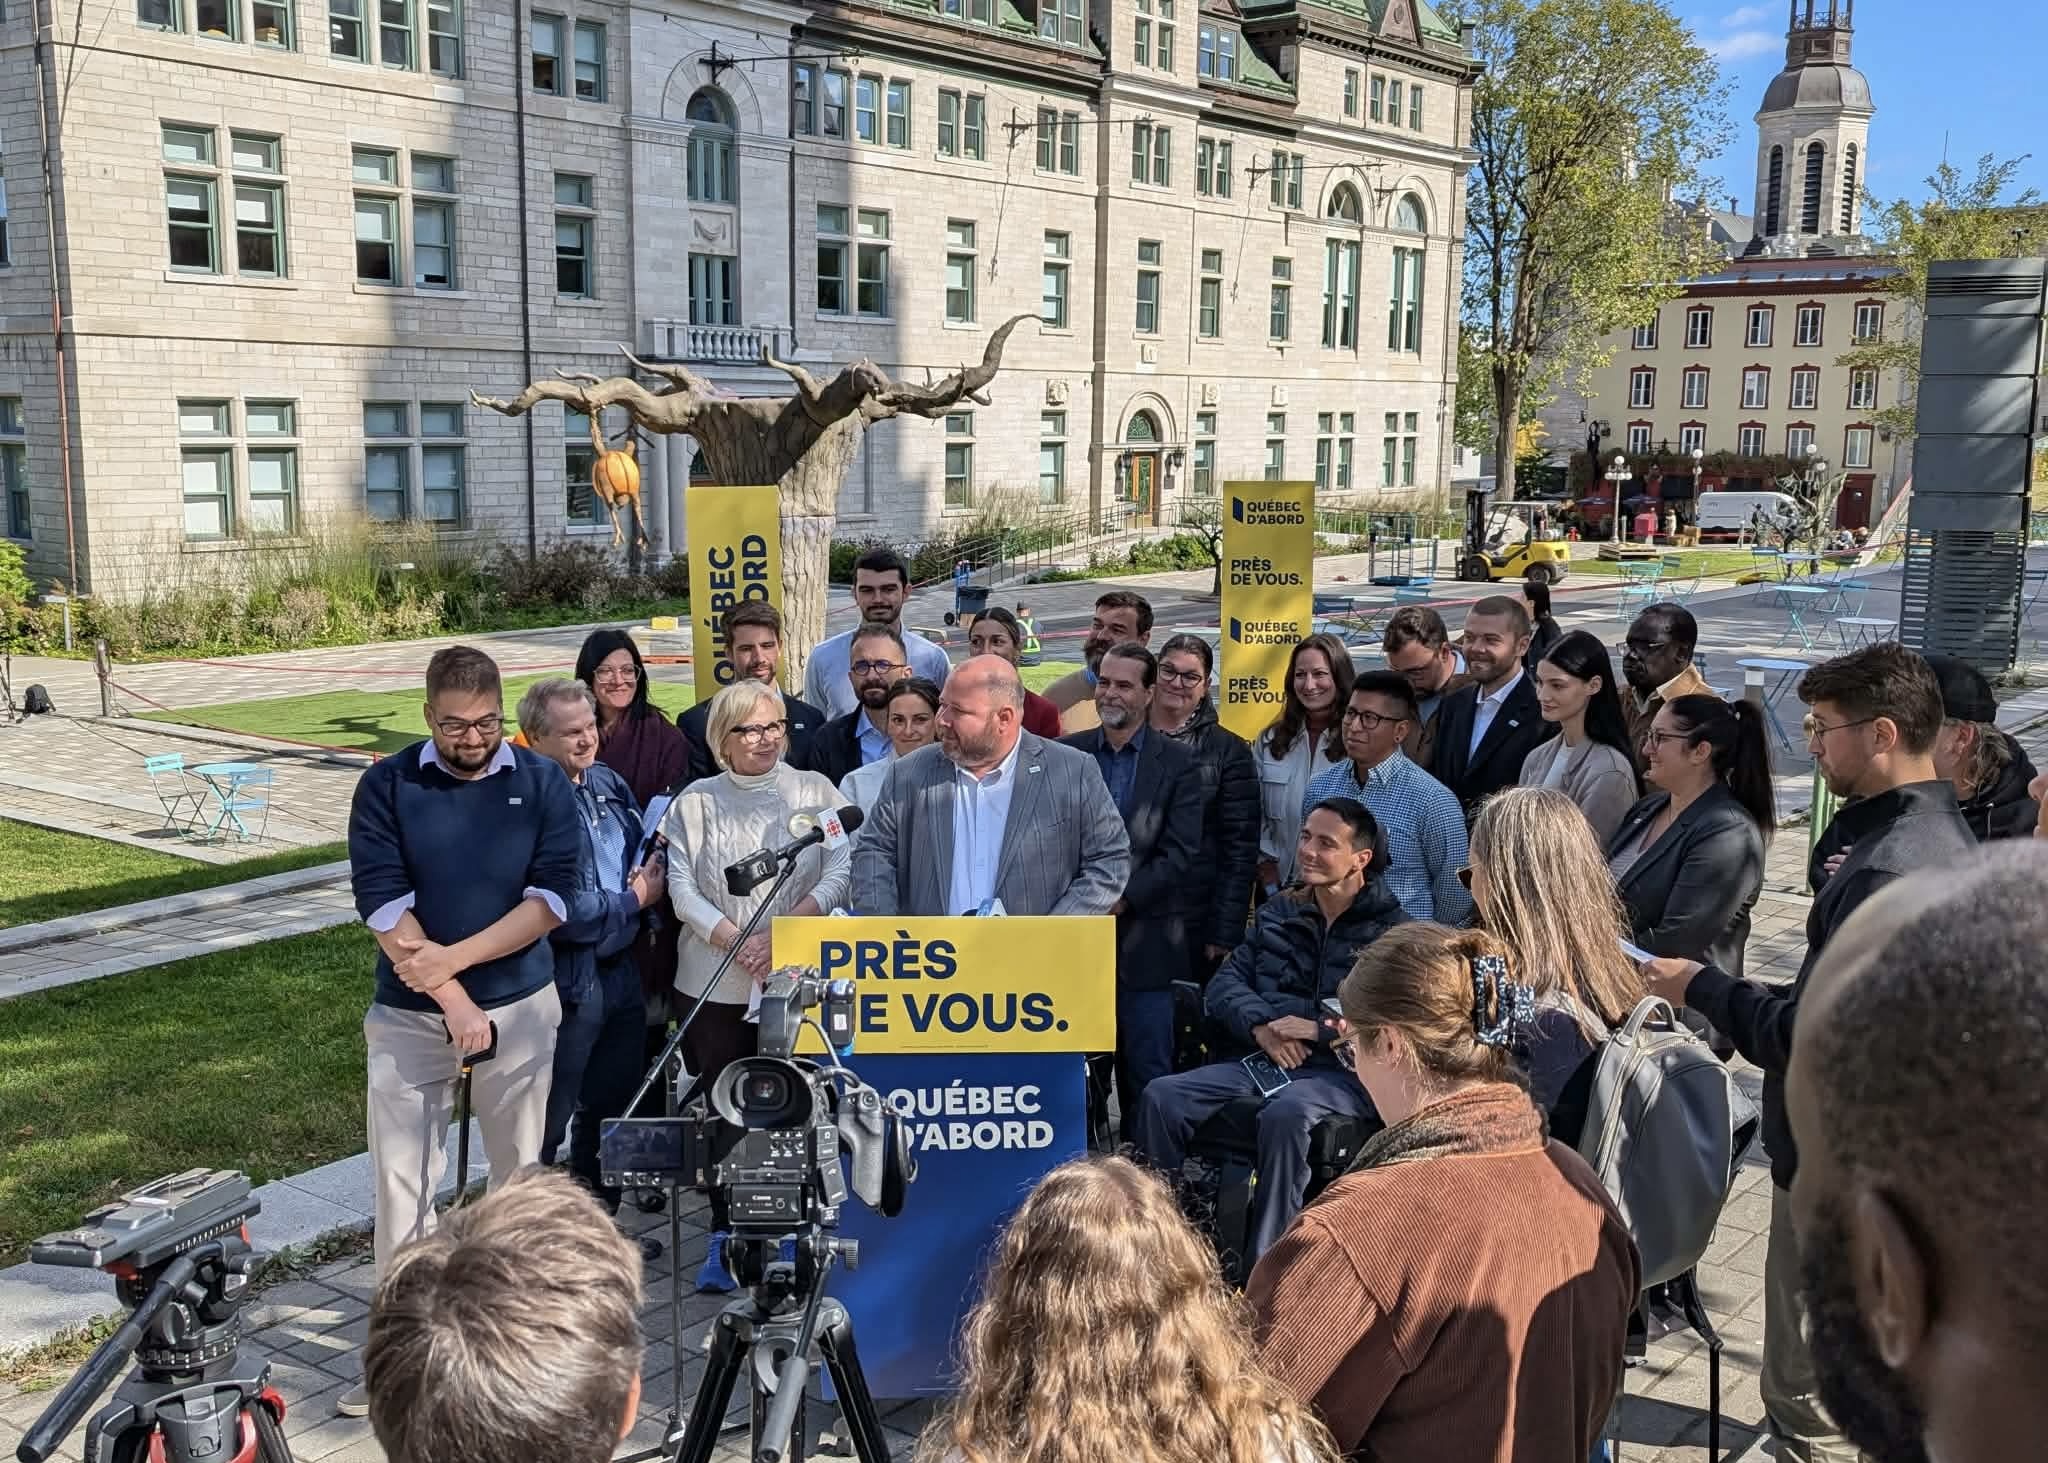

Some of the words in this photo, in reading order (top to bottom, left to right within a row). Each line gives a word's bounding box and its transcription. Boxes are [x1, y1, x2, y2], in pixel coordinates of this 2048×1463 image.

[1246, 498, 1301, 512] QUÉBEC
[1246, 514, 1305, 525] D'ABORD
[1231, 555, 1271, 571] PRÈS
[1230, 573, 1251, 586] DE
[1255, 572, 1304, 586] VOUS.
[1244, 619, 1299, 633] QUÉBEC
[1244, 634, 1302, 645] D'ABORD
[1228, 675, 1269, 690] PRÈS
[1228, 691, 1249, 704] DE
[1252, 691, 1287, 704] VOU
[820, 929, 958, 980] PRÈS
[903, 992, 1069, 1033] VOUS.
[887, 1078, 1041, 1118] QUÉBEC
